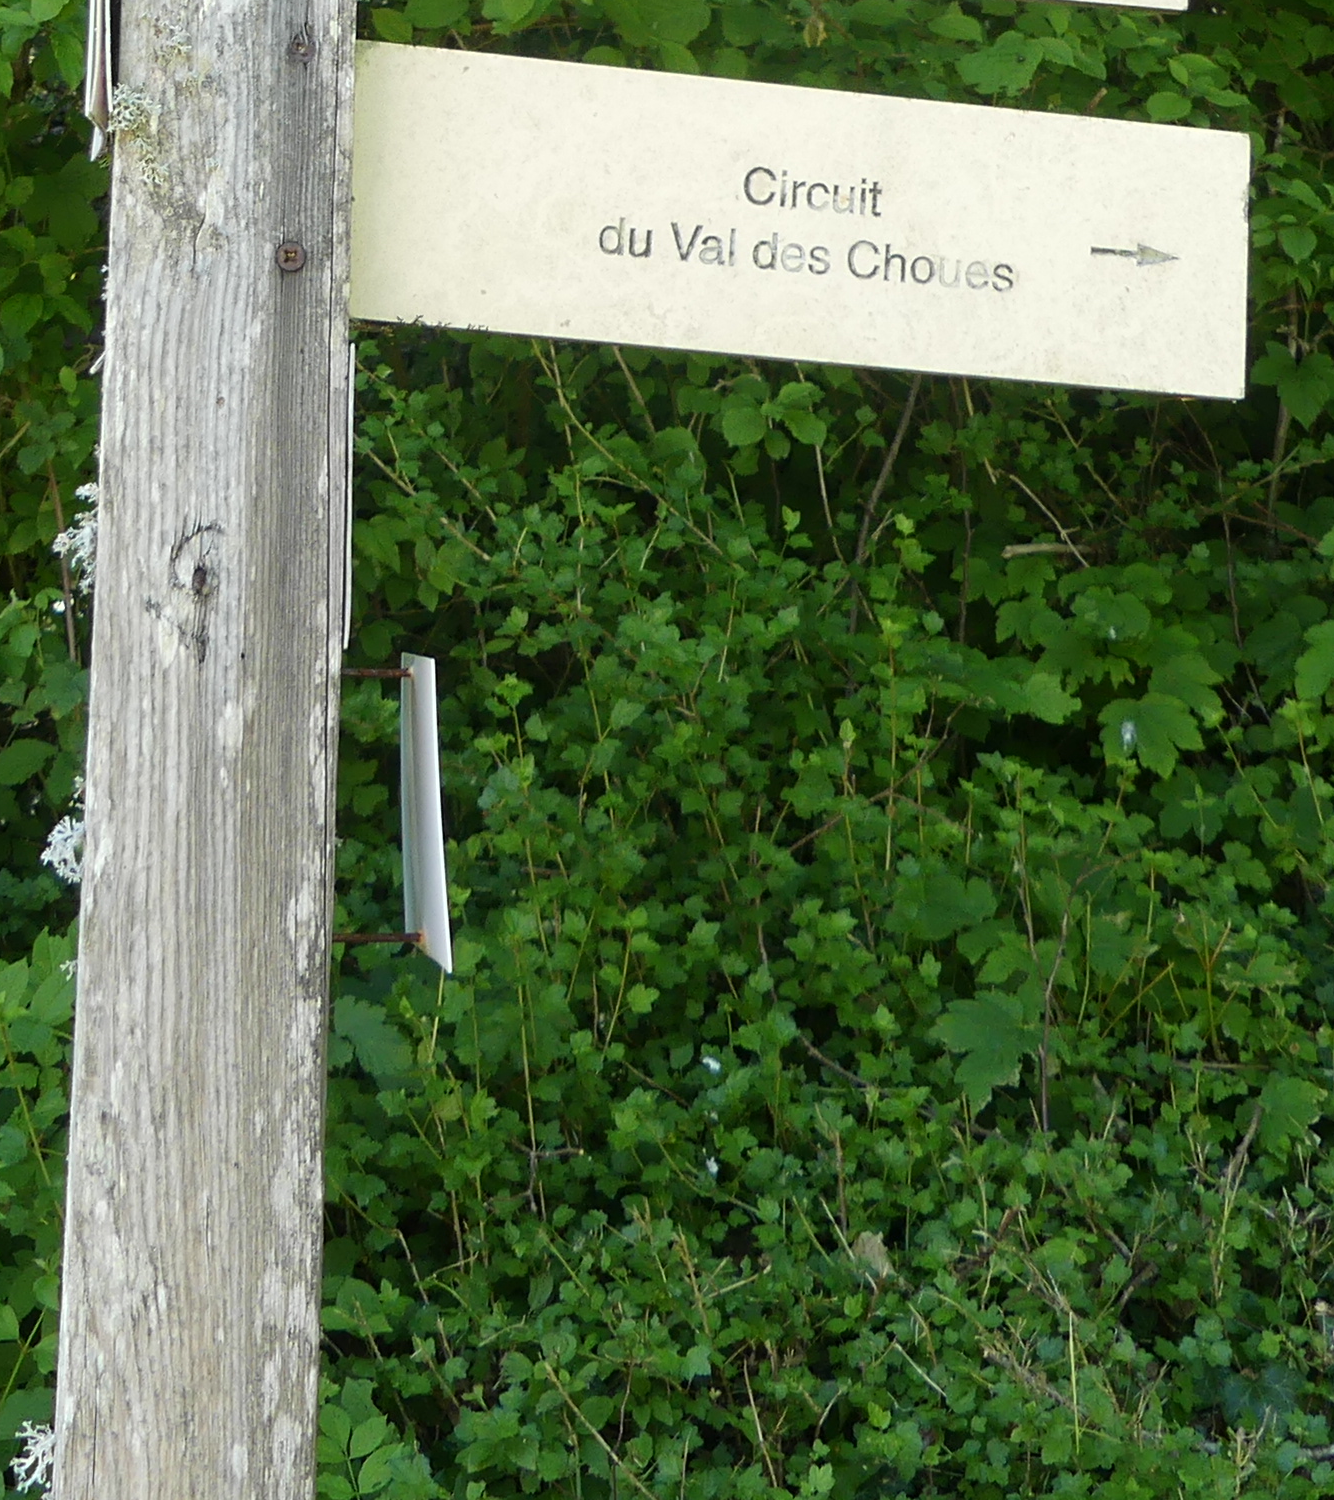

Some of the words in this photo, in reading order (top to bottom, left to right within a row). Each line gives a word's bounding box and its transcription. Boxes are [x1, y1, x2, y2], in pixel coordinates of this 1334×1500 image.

[742, 166, 883, 218] Circuit
[599, 218, 653, 258] du
[670, 222, 735, 267] Val
[752, 232, 831, 275] des
[846, 240, 1015, 292] Choues
